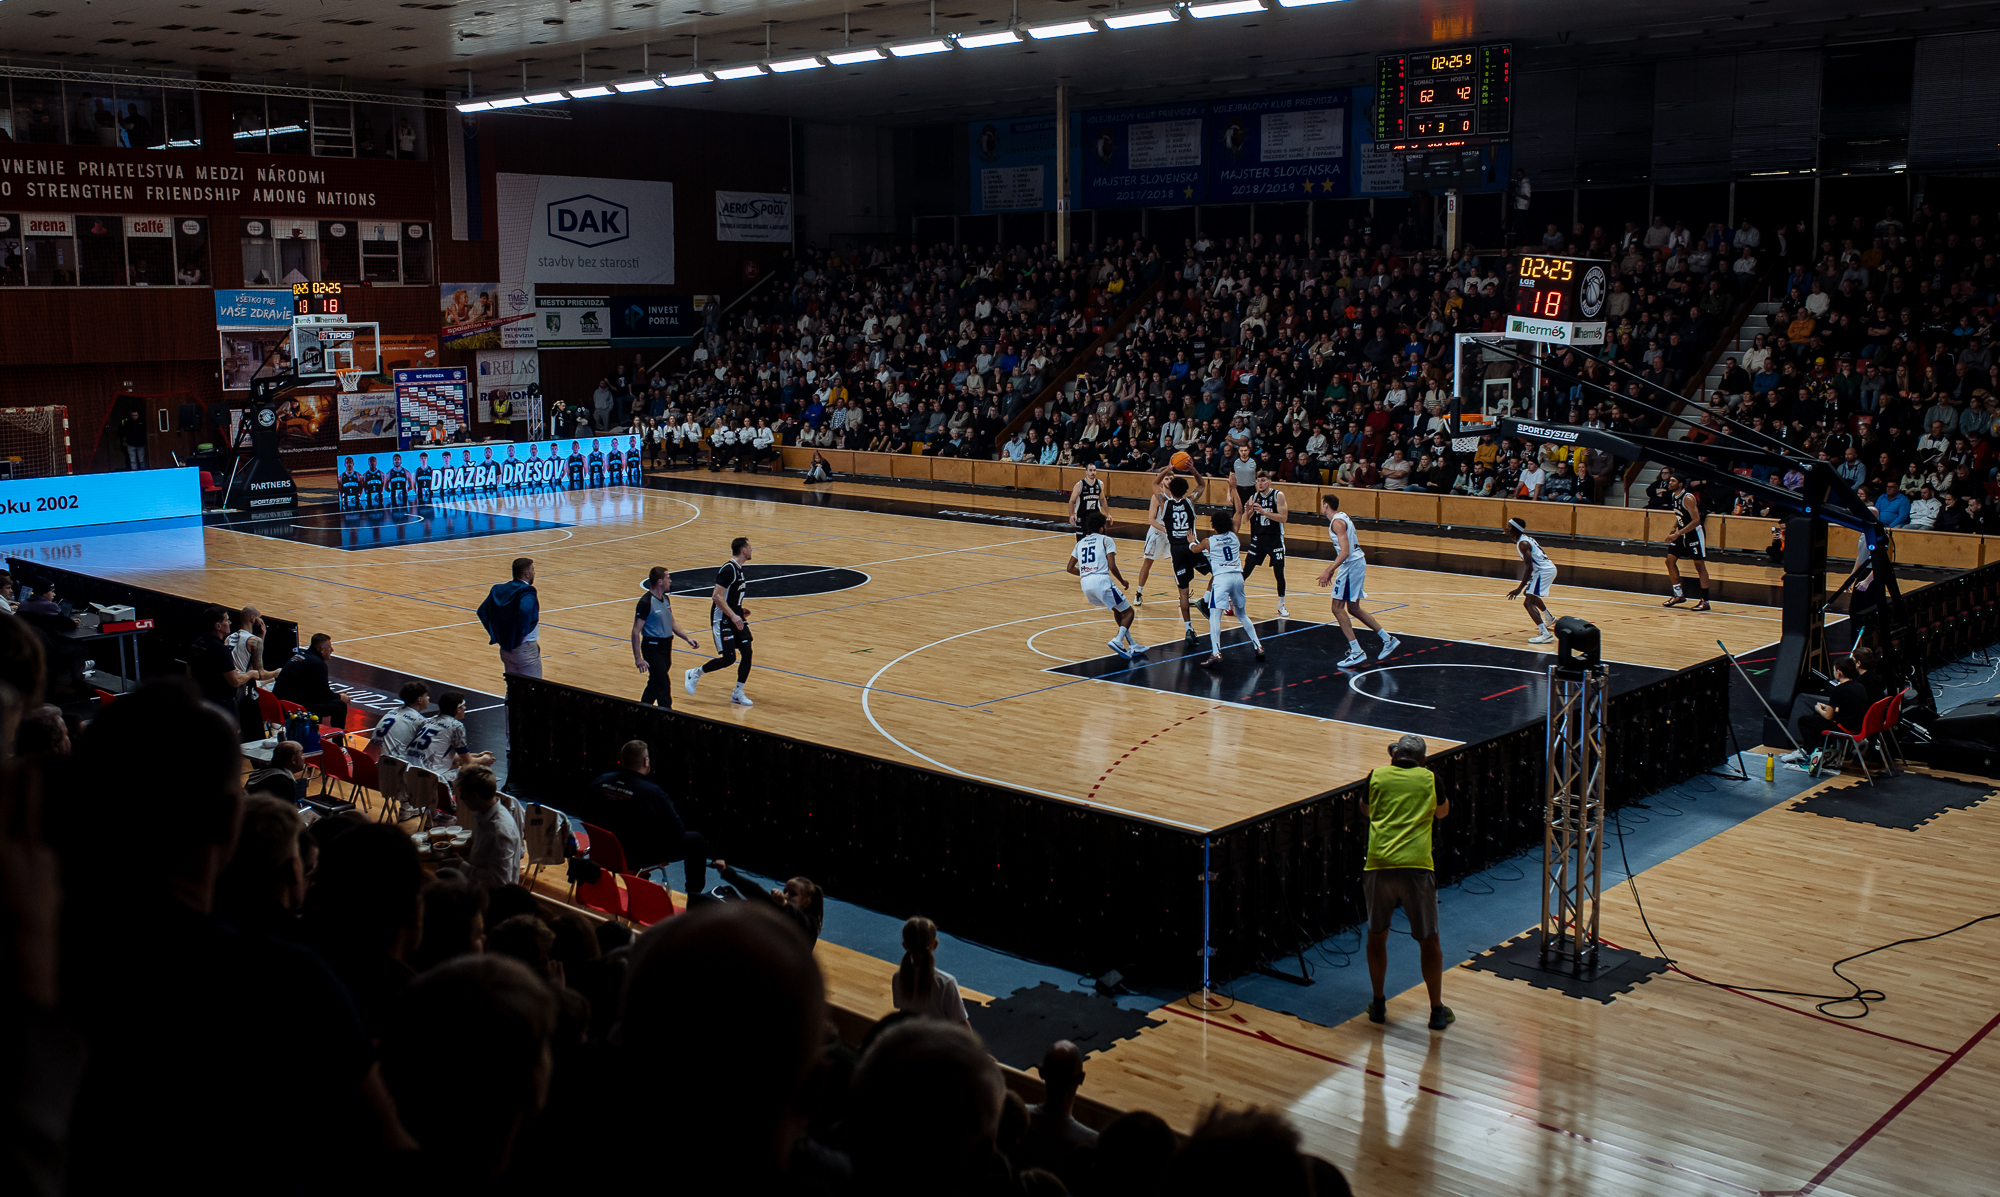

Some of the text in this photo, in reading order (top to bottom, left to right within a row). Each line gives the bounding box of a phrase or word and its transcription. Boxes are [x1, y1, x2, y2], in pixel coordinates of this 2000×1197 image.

[1420, 89, 1434, 103] 62
[1456, 86, 1471, 100] 42
[1213, 96, 1339, 113] VOLEJBALOVÝ KLUB PRIEVIDZA
[1086, 108, 1197, 124] VOLEJBALOVÝ KLUB PRIEVIDZA
[1419, 124, 1425, 133] 4
[1438, 122, 1445, 133] 3
[1462, 120, 1470, 131] 0
[78, 162, 184, 179] PRIATEĽSTVA
[196, 166, 244, 180] MEDZI
[257, 164, 325, 184] NÁRODMI
[1220, 164, 1341, 180] MAJSTER SLOVENSKA
[1093, 172, 1199, 187] MAJSTER SLOVENSKA
[27, 182, 133, 200] STRENGTHEN
[146, 186, 241, 201] FRIENDSHIP
[253, 188, 306, 204] AMONG
[317, 191, 376, 207] NATIONS
[1116, 189, 1174, 200] 2017/2018
[1231, 183, 1295, 195] 2018/2019
[1059, 202, 1062, 211] A
[1449, 200, 1454, 211] B
[30, 220, 66, 232] arena
[134, 220, 163, 233] caffé
[558, 209, 620, 234] DAK
[538, 256, 639, 269] stavby bez starostí
[1520, 257, 1573, 281] 02:25
[235, 293, 275, 305] VŠETKO PRE
[323, 299, 338, 312] 18
[1533, 291, 1561, 316] 18
[220, 303, 247, 317] VAŠE
[648, 306, 679, 314] INVEST
[648, 316, 679, 325] PORTAL
[1522, 322, 1566, 340] hermés
[431, 458, 565, 491] DRAŽBA DRESOV
[250, 480, 291, 490] PARTNERS
[36, 495, 79, 511] 2002
[1172, 512, 1189, 530] 32
[1081, 546, 1096, 564] 35
[376, 718, 396, 737] 3
[410, 729, 439, 750] 25
